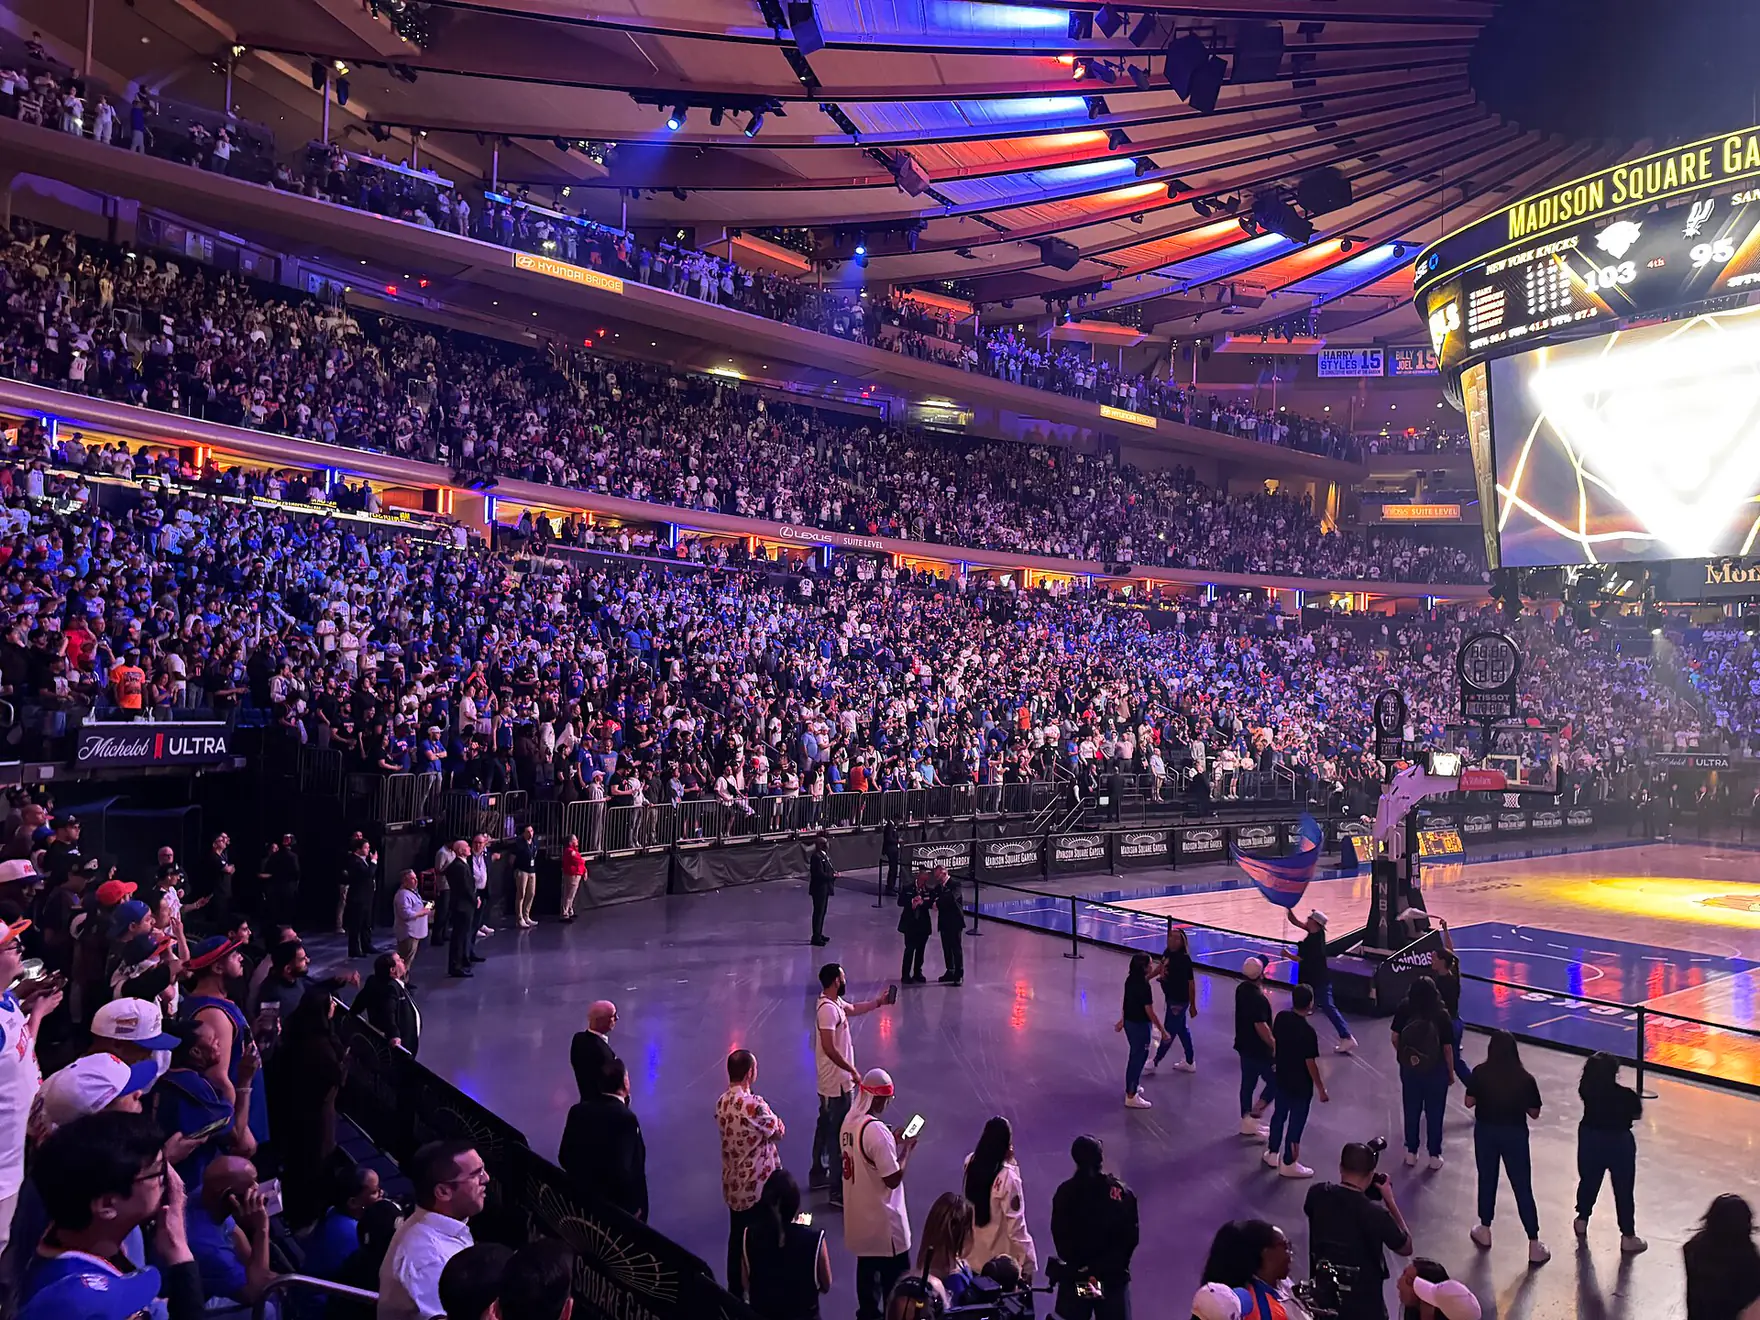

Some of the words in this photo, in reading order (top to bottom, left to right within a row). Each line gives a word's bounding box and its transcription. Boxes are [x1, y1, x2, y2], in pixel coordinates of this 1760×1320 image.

[1508, 178, 1604, 241] MADISON
[1611, 146, 1713, 205] SQUARE
[1486, 258, 1507, 276] NEW
[1508, 249, 1534, 268] YORK
[1536, 235, 1579, 257] KNICKS
[1689, 236, 1735, 269] 95
[1647, 257, 1666, 269] 4th
[538, 261, 584, 281] HYUNDAI
[585, 274, 621, 290] BRIDGE
[1582, 260, 1637, 294] 103
[1323, 350, 1354, 360] HARRY
[1361, 350, 1381, 370] 15
[1395, 350, 1414, 360] BILLY
[1416, 350, 1438, 370] 15
[1320, 360, 1357, 370] STYLES
[1396, 360, 1413, 370] JOEL
[1411, 507, 1433, 516] SUITE
[1434, 507, 1457, 516] LEVEL
[794, 531, 832, 543] LEXUS
[843, 537, 862, 547] SUITE
[863, 540, 883, 549] LEVEL
[1477, 693, 1510, 701] TISSOT
[77, 735, 150, 761] Michelob
[168, 736, 226, 756] ULTRA
[1695, 758, 1729, 767] ULTRA
[1055, 849, 1073, 859] MADISON
[1074, 848, 1089, 858] SQUARE
[1089, 847, 1105, 857] GARDEN
[1120, 845, 1138, 855] MADISON
[1138, 844, 1152, 854] SQUARE
[1152, 843, 1167, 853] GARDEN
[985, 856, 1004, 866] MADISON
[1005, 854, 1021, 864] SQUARE
[1021, 852, 1038, 862] GARDEN
[1378, 882, 1388, 928] NBA
[574, 1255, 622, 1319] SQUARE
